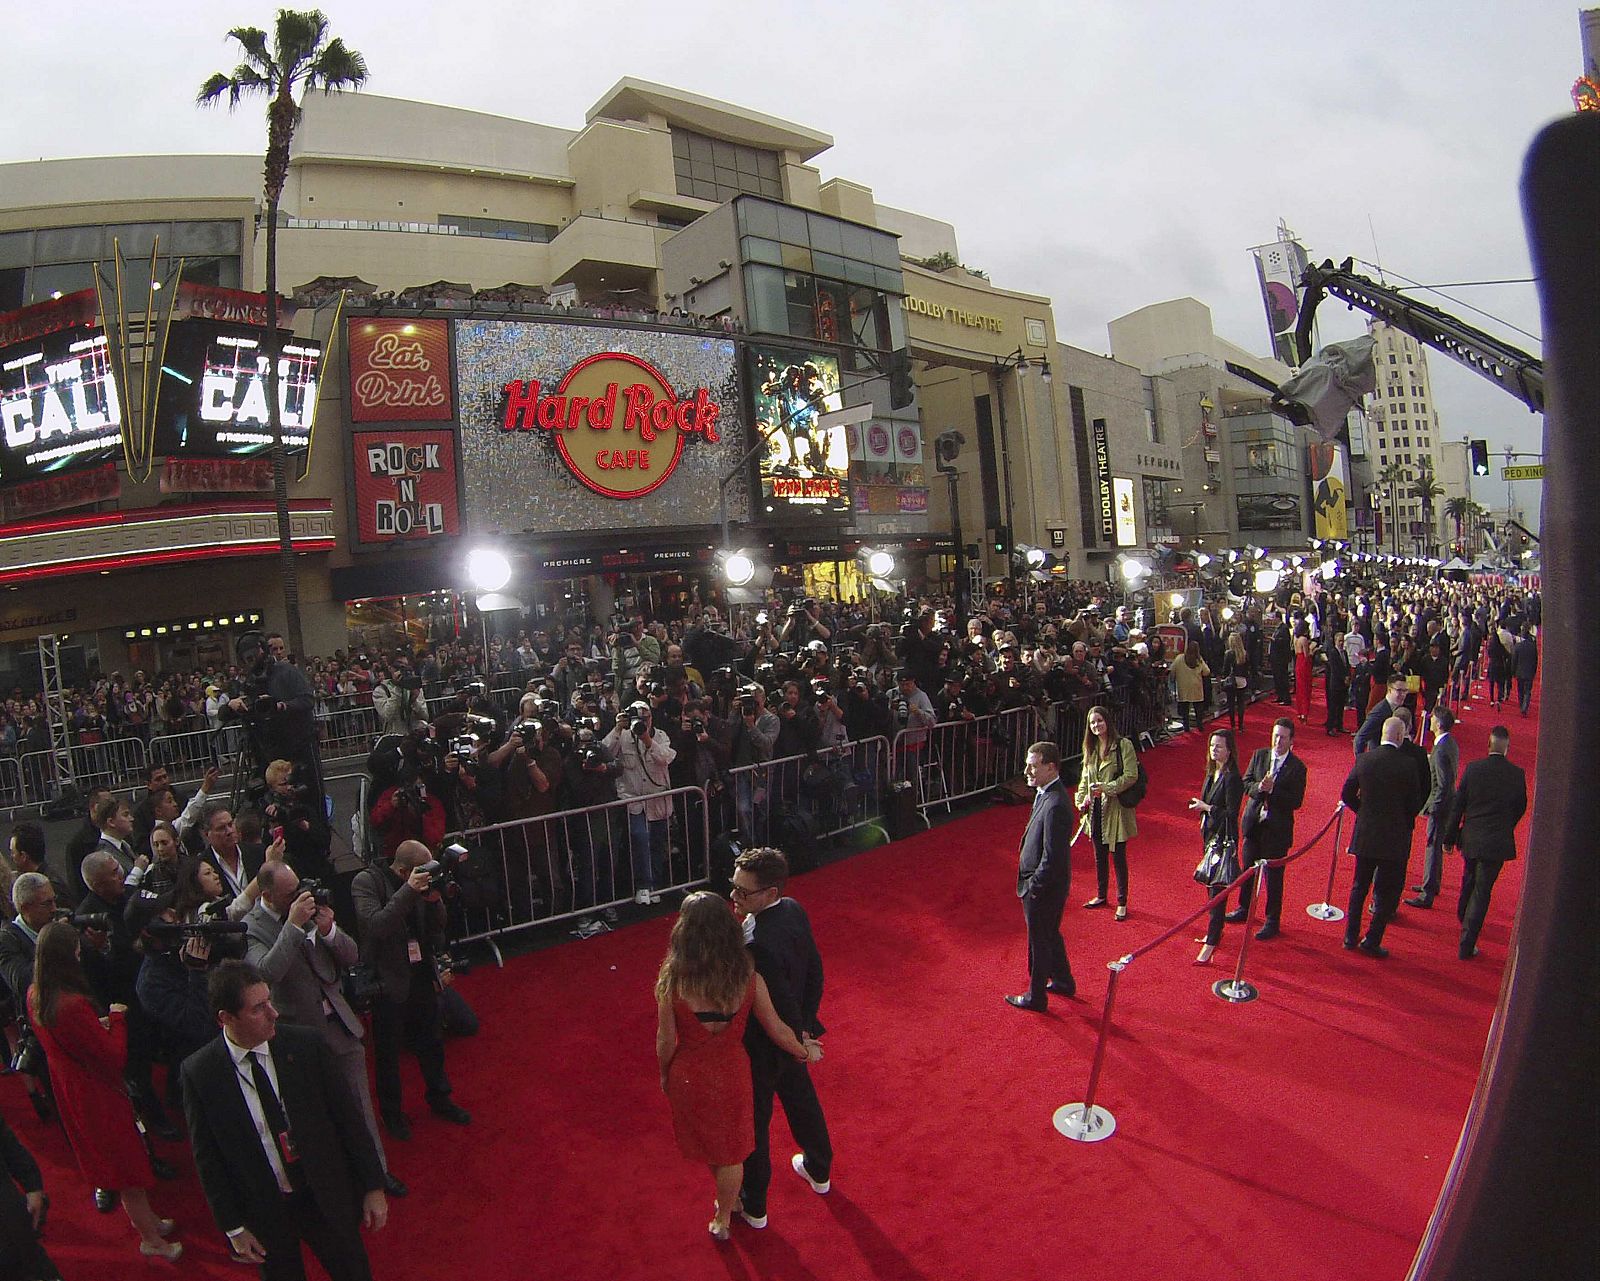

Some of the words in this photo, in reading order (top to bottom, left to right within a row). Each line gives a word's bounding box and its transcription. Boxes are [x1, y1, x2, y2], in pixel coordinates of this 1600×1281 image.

[909, 295, 947, 319] DOLBY
[950, 307, 1004, 332] THEATRE
[368, 333, 430, 371] Eat,
[356, 370, 444, 407] Drink
[505, 379, 619, 430] Hard
[624, 383, 720, 442] Rock
[367, 442, 440, 474] ROCK
[596, 449, 651, 470] CAFE
[1095, 426, 1109, 477] THEATRE
[1137, 454, 1181, 471] SEPHORA
[1504, 469, 1522, 479] PED
[1101, 479, 1112, 517] DOLBY
[375, 500, 444, 535] ROLL
[543, 558, 592, 568] PREMIERE
[654, 551, 691, 559] PREMIERE
